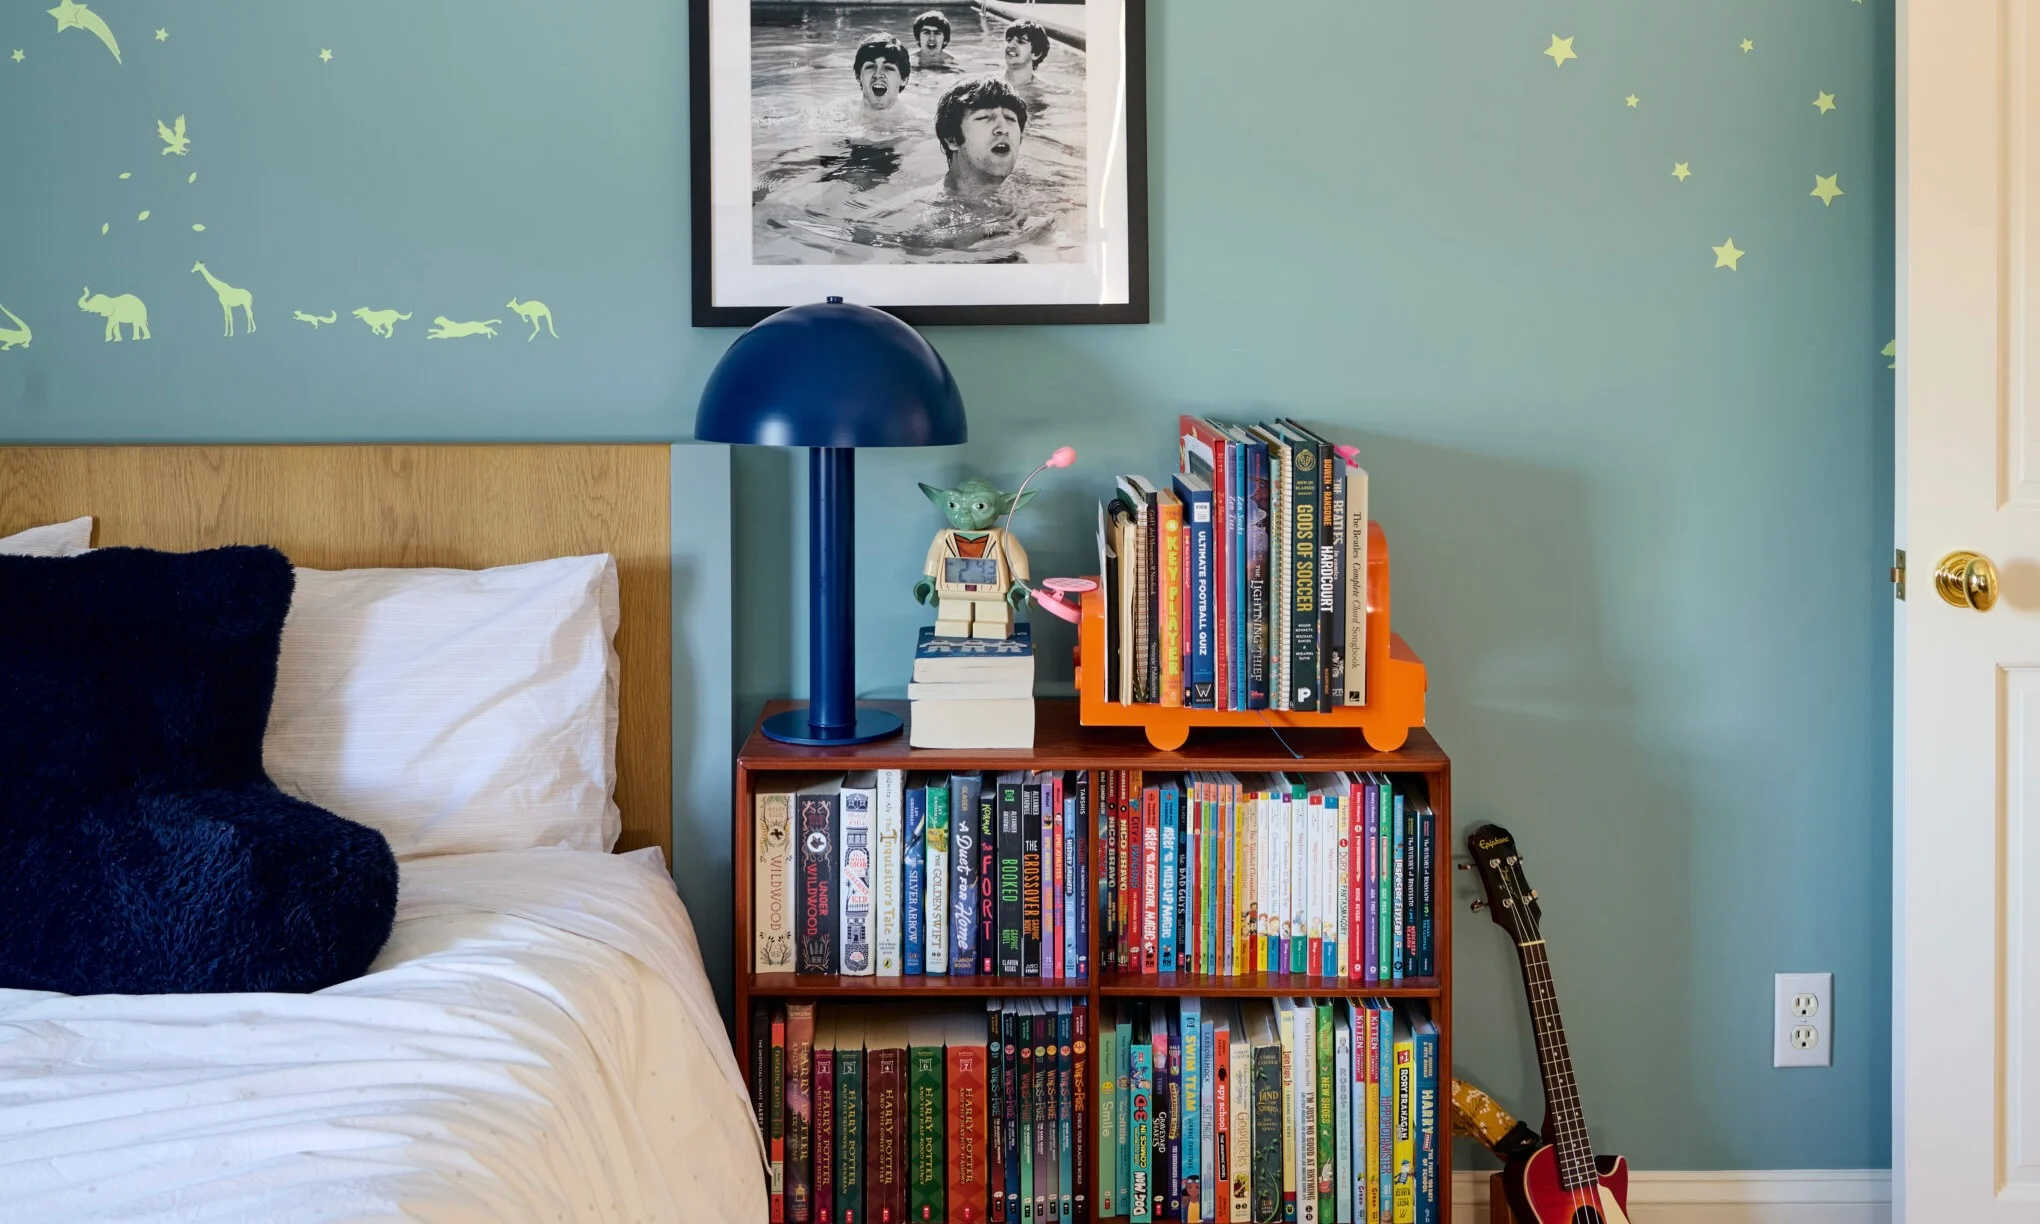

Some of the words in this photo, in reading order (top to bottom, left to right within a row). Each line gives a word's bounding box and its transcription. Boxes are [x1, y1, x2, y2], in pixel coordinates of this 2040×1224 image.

[1323, 459, 1332, 484] BOWEN
[1237, 496, 1245, 511] Zen
[1323, 491, 1332, 526] RANSOME
[1237, 514, 1245, 536] Socks
[1297, 504, 1313, 539] GODS
[1353, 512, 1361, 528] The
[1168, 536, 1179, 582] KEY
[1198, 531, 1207, 577] ULTIMATE
[1297, 542, 1313, 558] OF
[1352, 530, 1361, 559] Beatles
[1297, 561, 1313, 612] SOCCER
[1321, 546, 1333, 612] HARDCOURT
[1351, 562, 1361, 598] Complete
[1198, 579, 1207, 630] FOOTBALL
[1250, 579, 1264, 645] LIGHTNING
[1352, 600, 1361, 623] Chord
[1168, 586, 1179, 675] PLAYER
[1199, 632, 1207, 655] QUIZ
[1350, 625, 1361, 669] Songbook
[1251, 649, 1263, 681] THIEF
[959, 821, 969, 832] A
[982, 803, 992, 835] KORMAN
[1131, 816, 1139, 835] CITY
[1025, 841, 1037, 851] THE
[1145, 828, 1157, 849] Aster
[1479, 837, 1509, 849] Epiphone
[956, 835, 972, 877] Duet
[1131, 844, 1139, 888] DRAGONS
[1340, 852, 1348, 871] DORY
[770, 855, 781, 931] WILDWOOD
[909, 870, 918, 903] SILVER
[932, 867, 941, 911] GOLDEN
[1002, 859, 1018, 902] BOOKED
[1024, 854, 1039, 915] CROSSOVER
[1145, 864, 1156, 908] ACCIDENTAL
[1394, 859, 1403, 900] Inspector
[807, 863, 818, 935] WILDWOOD
[819, 881, 828, 916] UNDER
[981, 855, 993, 940] FORT
[1178, 889, 1186, 914] GUYS
[884, 908, 895, 934] Tale
[908, 906, 918, 944] ARROW
[932, 913, 941, 949] SWIFT
[955, 901, 972, 949] Home
[1144, 911, 1155, 940] MAGIC
[1161, 905, 1173, 938] MAGIC
[1394, 902, 1402, 936] Flytrap
[1002, 929, 1010, 945] NOVEL
[801, 1041, 809, 1096] HARRY
[1185, 1036, 1196, 1071] SWIM
[991, 1067, 1000, 1092] WINGS
[1005, 1068, 1015, 1095] WINGS
[1021, 1073, 1030, 1099] WINGS
[1035, 1071, 1045, 1099] WINGS
[1047, 1069, 1057, 1095] WINGS
[1061, 1070, 1070, 1096] WINGS
[1074, 1060, 1085, 1087] WINGS
[1321, 1077, 1331, 1096] NEW
[1340, 1068, 1348, 1110] ROBOT
[1399, 1068, 1408, 1093] RORY
[925, 1087, 933, 1132] HARRY
[965, 1088, 973, 1132] HARRY
[991, 1098, 1000, 1116] FIRE
[1005, 1100, 1015, 1119] FIRE
[1047, 1101, 1057, 1119] FIRE
[1074, 1092, 1085, 1111] FIRE
[1134, 1095, 1148, 1121] 3-D
[1169, 1085, 1177, 1119] HAZARDOUS
[1185, 1076, 1196, 1112] TEAM
[1260, 1091, 1278, 1100] LAND
[1306, 1092, 1315, 1100] I'M
[822, 1090, 830, 1134] HARRY
[848, 1090, 856, 1134] HARRY
[885, 1089, 893, 1134] HARRY
[1021, 1103, 1030, 1121] FIRE
[1035, 1103, 1045, 1121] FIRE
[1061, 1101, 1070, 1120] FIRE
[1102, 1101, 1113, 1137] Smile
[1203, 1104, 1212, 1119] SALT
[1306, 1104, 1315, 1123] JUST
[1321, 1097, 1331, 1124] SHOES
[1399, 1094, 1408, 1140] BRANAGAN
[1422, 1090, 1433, 1134] HARRY
[801, 1104, 809, 1161] POTTER
[1140, 1124, 1146, 1134] IN
[1169, 1120, 1177, 1137] TALES
[1203, 1122, 1212, 1141] MAGIC
[1235, 1112, 1249, 1167] GOLDILOCKS
[1306, 1126, 1315, 1135] NO
[1381, 1096, 1392, 1175] HIPPOPOTAMISTER
[822, 1140, 830, 1185] POTTER
[848, 1140, 856, 1185] POTTER
[885, 1139, 893, 1184] POTTER
[925, 1137, 933, 1182] POTTER
[965, 1137, 973, 1182] POTTER
[1306, 1137, 1315, 1156] GOOD
[1306, 1158, 1315, 1167] AT
[1422, 1158, 1428, 1166] OF
[1133, 1172, 1146, 1193] MAN
[1306, 1168, 1315, 1200] RHYMING
[1133, 1194, 1146, 1216] DOG
